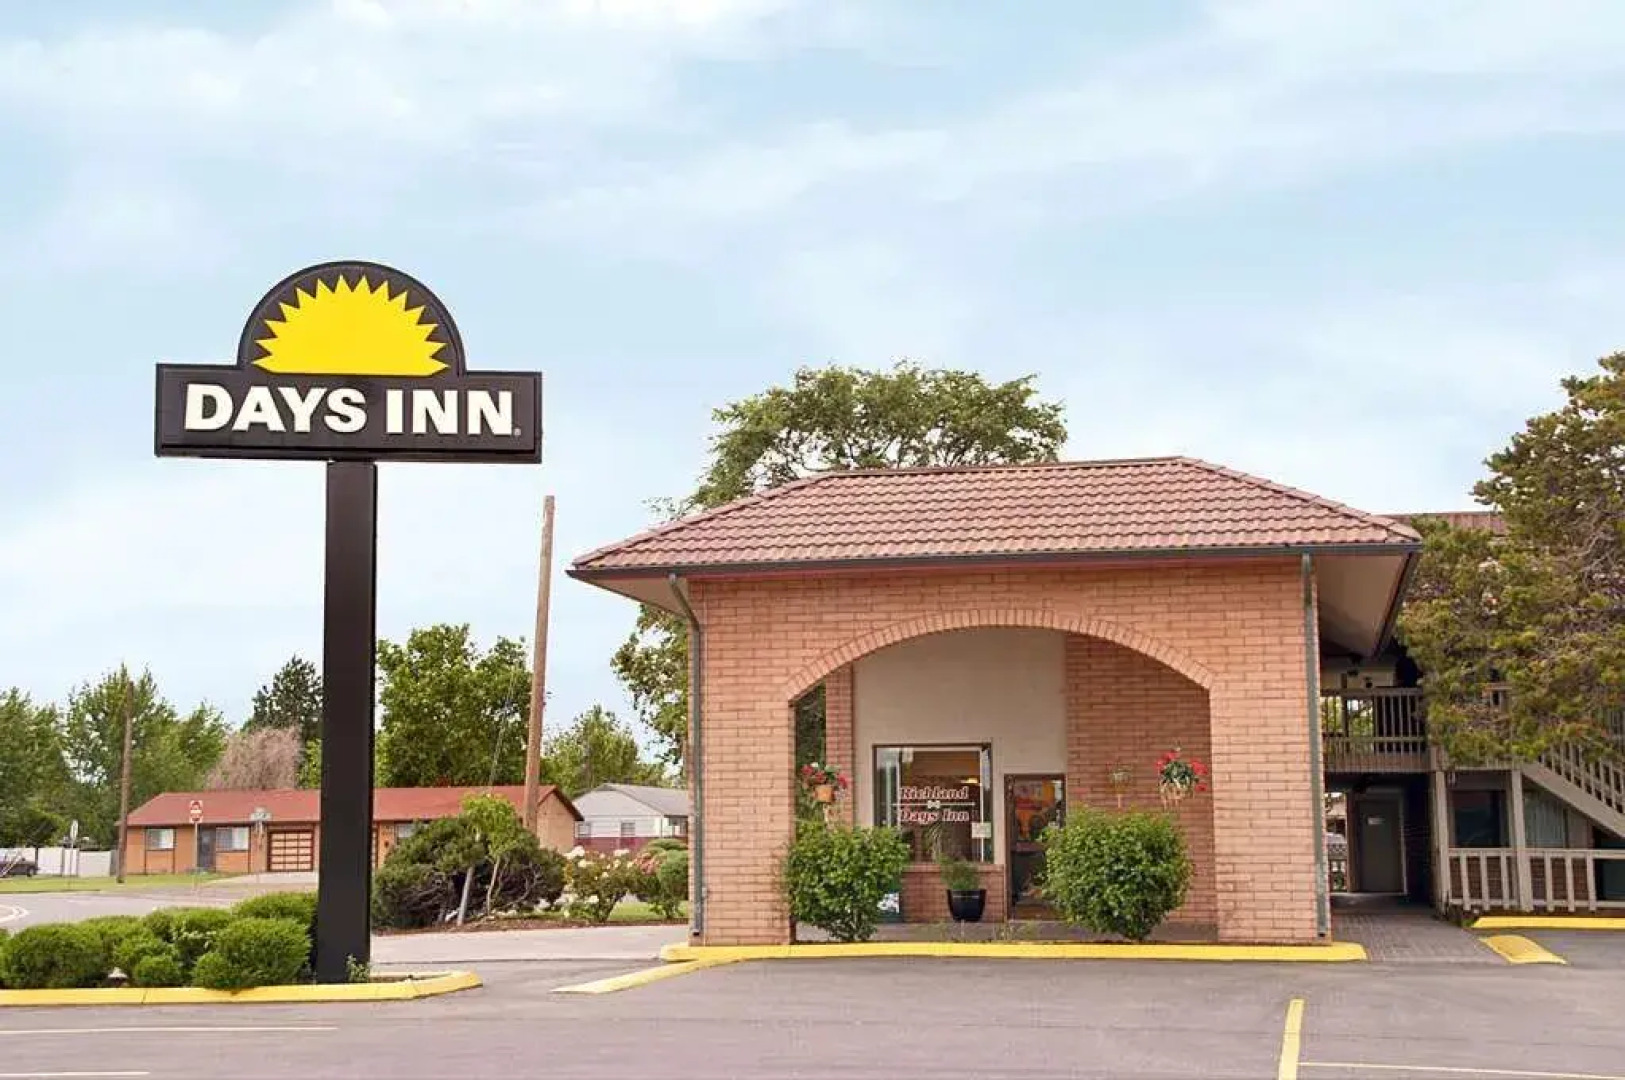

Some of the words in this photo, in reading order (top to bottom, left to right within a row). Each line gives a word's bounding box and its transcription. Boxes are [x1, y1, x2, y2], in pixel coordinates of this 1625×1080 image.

[184, 383, 368, 433] DAYS
[385, 389, 513, 436] INN
[900, 785, 970, 800] Richland
[900, 808, 939, 825] Days
[942, 808, 970, 821] Inn
